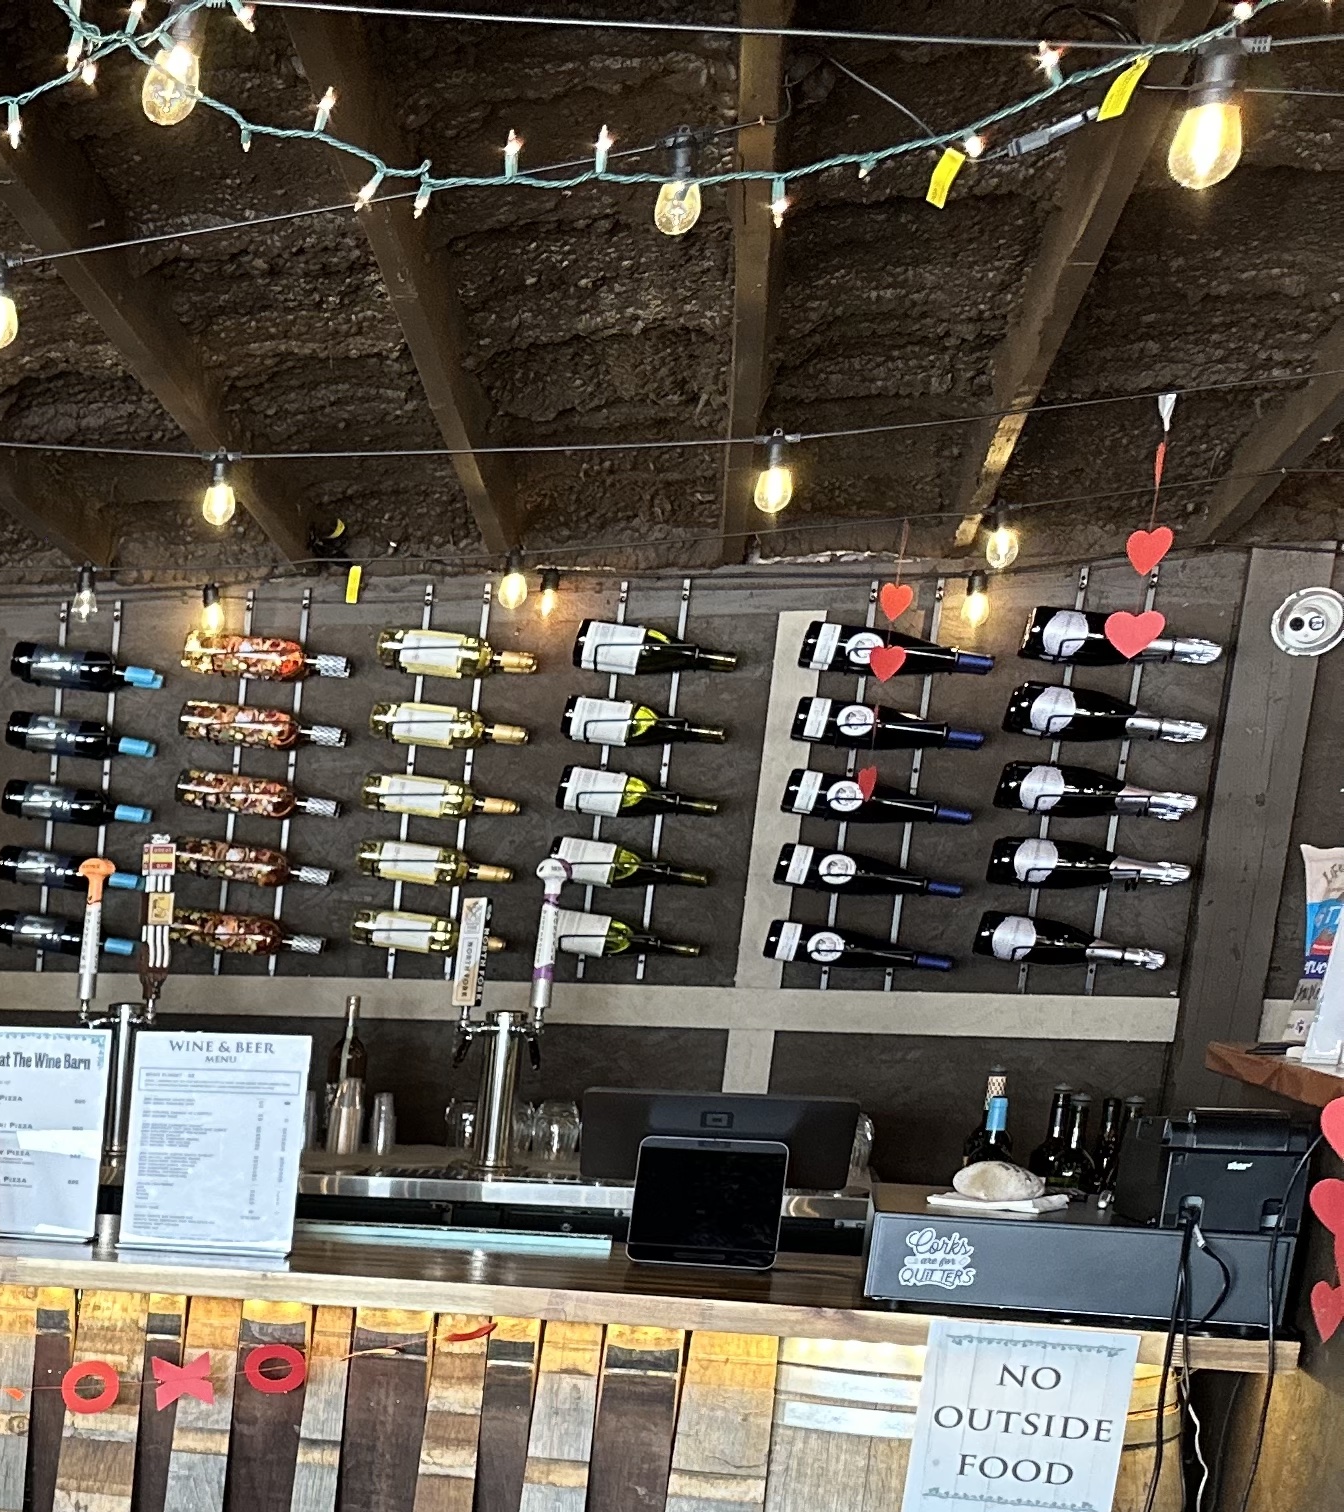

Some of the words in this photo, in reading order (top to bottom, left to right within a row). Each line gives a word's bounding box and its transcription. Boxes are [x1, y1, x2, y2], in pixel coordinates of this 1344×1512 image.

[479, 928, 490, 967] NORTH
[476, 971, 486, 1001] FORK
[169, 1040, 213, 1053] WINE
[218, 1041, 230, 1053] &
[236, 1042, 275, 1054] BEER
[205, 1055, 237, 1063] MENU
[0, 1052, 10, 1067] at
[13, 1052, 32, 1068] The
[35, 1053, 61, 1069] Wine
[64, 1053, 91, 1070] Barn
[908, 1229, 972, 1256] Corks
[901, 1267, 973, 1287] QUITTERS
[995, 1363, 1062, 1390] NO
[933, 1404, 1113, 1443] OUTSIDE
[957, 1453, 1074, 1486] FOOD
